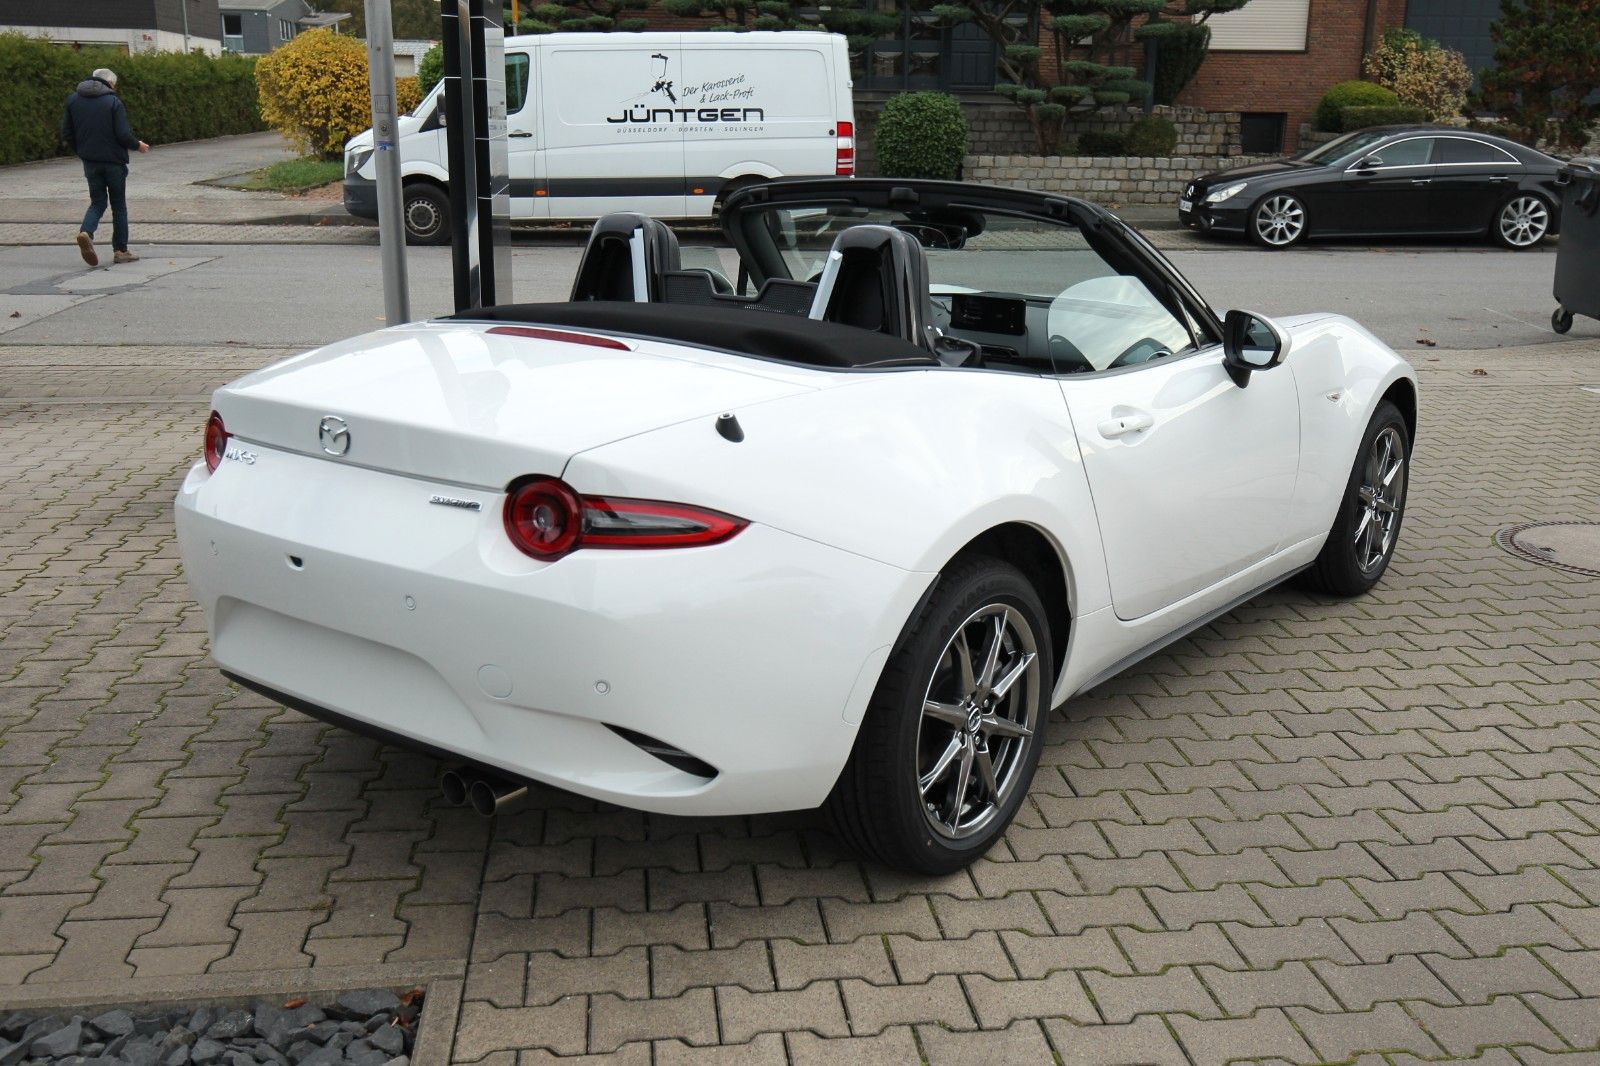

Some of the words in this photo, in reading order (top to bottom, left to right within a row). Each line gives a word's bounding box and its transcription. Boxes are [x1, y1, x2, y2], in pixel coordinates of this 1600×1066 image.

[682, 87, 699, 97] Der
[701, 73, 745, 92] Karosserie
[700, 94, 706, 103] &
[709, 86, 755, 103] Lack-Profi
[226, 448, 256, 464] MX-5
